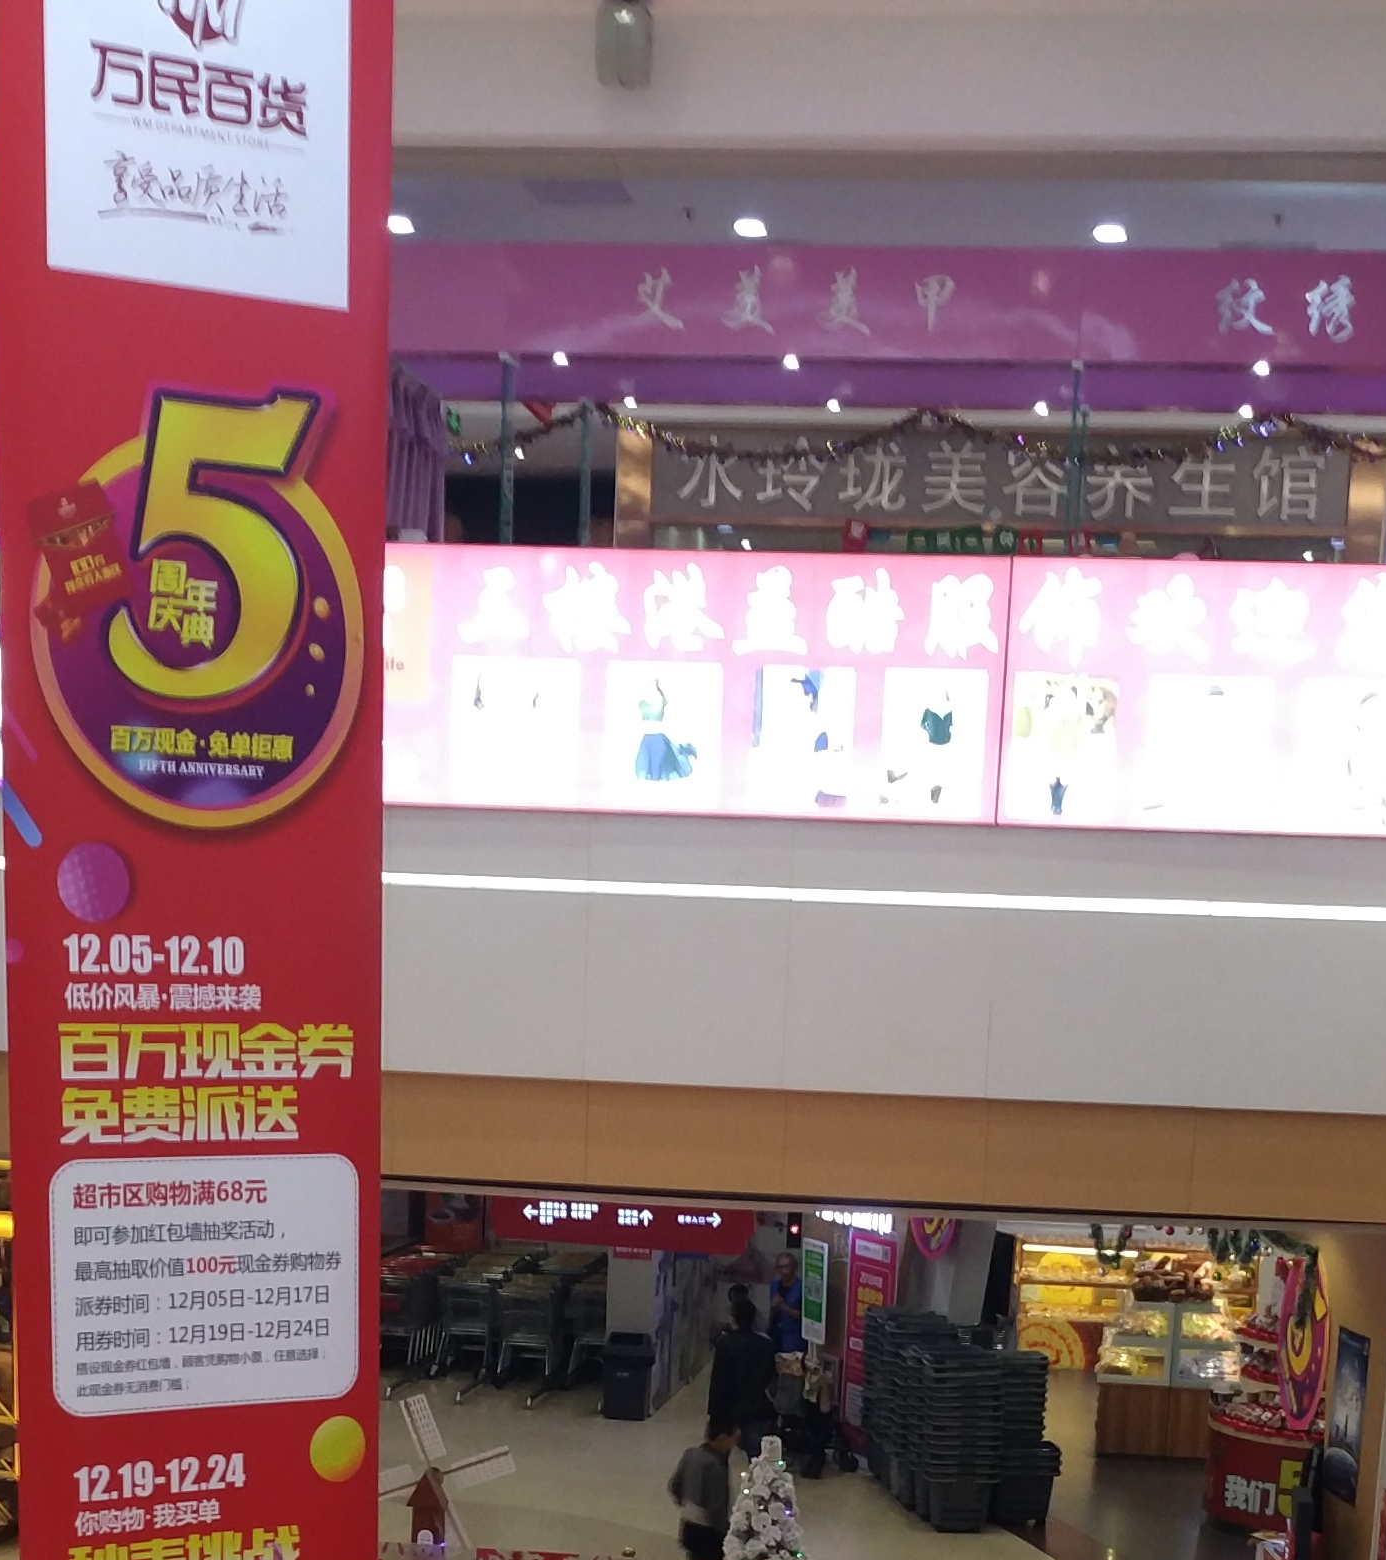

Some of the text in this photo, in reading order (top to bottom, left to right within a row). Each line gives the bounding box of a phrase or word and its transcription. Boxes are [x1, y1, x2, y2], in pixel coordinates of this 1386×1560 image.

[90, 40, 308, 139] 万民百货
[138, 758, 265, 780] FIFTH ANNIVERSARY
[63, 933, 245, 976] 12.05-12.10
[58, 1022, 354, 1081] 百万现金券
[60, 1086, 300, 1144] 免费派送
[73, 1179, 268, 1210] 超市区购物满68元
[74, 1251, 343, 1282] 最高抽取价值100元现金券购物券
[73, 1453, 246, 1503] 12.19-12.24
